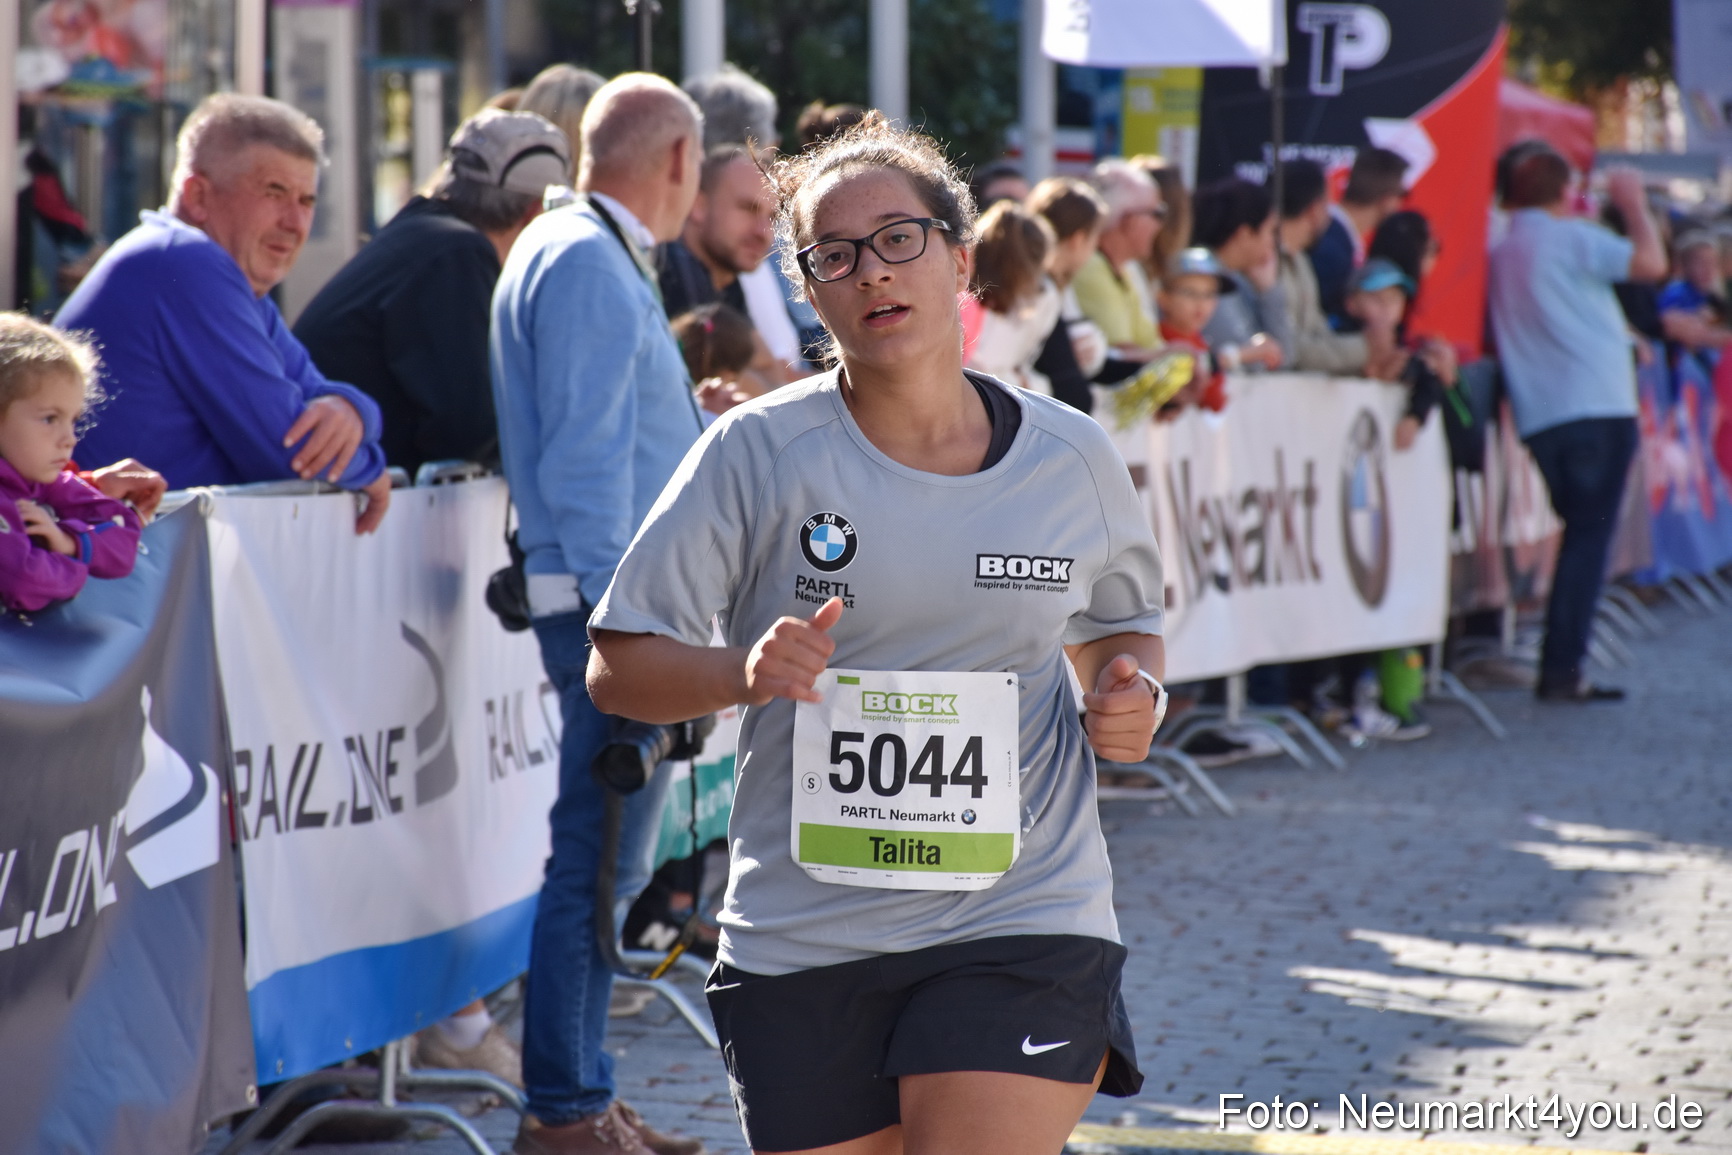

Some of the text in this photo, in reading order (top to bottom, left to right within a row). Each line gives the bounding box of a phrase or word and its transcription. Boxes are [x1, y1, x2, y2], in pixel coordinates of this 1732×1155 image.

[806, 513, 855, 537] BMW
[976, 553, 1075, 583] BOCK
[796, 574, 855, 598] PARTL
[974, 580, 1010, 590] inspired
[1012, 582, 1023, 591] by
[1025, 584, 1046, 592] smart
[795, 589, 855, 609] Neumkt
[862, 691, 958, 716] BOCK
[861, 713, 891, 722] inspired
[893, 715, 902, 724] by
[927, 717, 960, 725] concepts
[828, 730, 989, 799] 5044
[807, 777, 816, 790] S
[840, 805, 956, 823] PARTL Neumarkt
[869, 836, 941, 865] Talita
